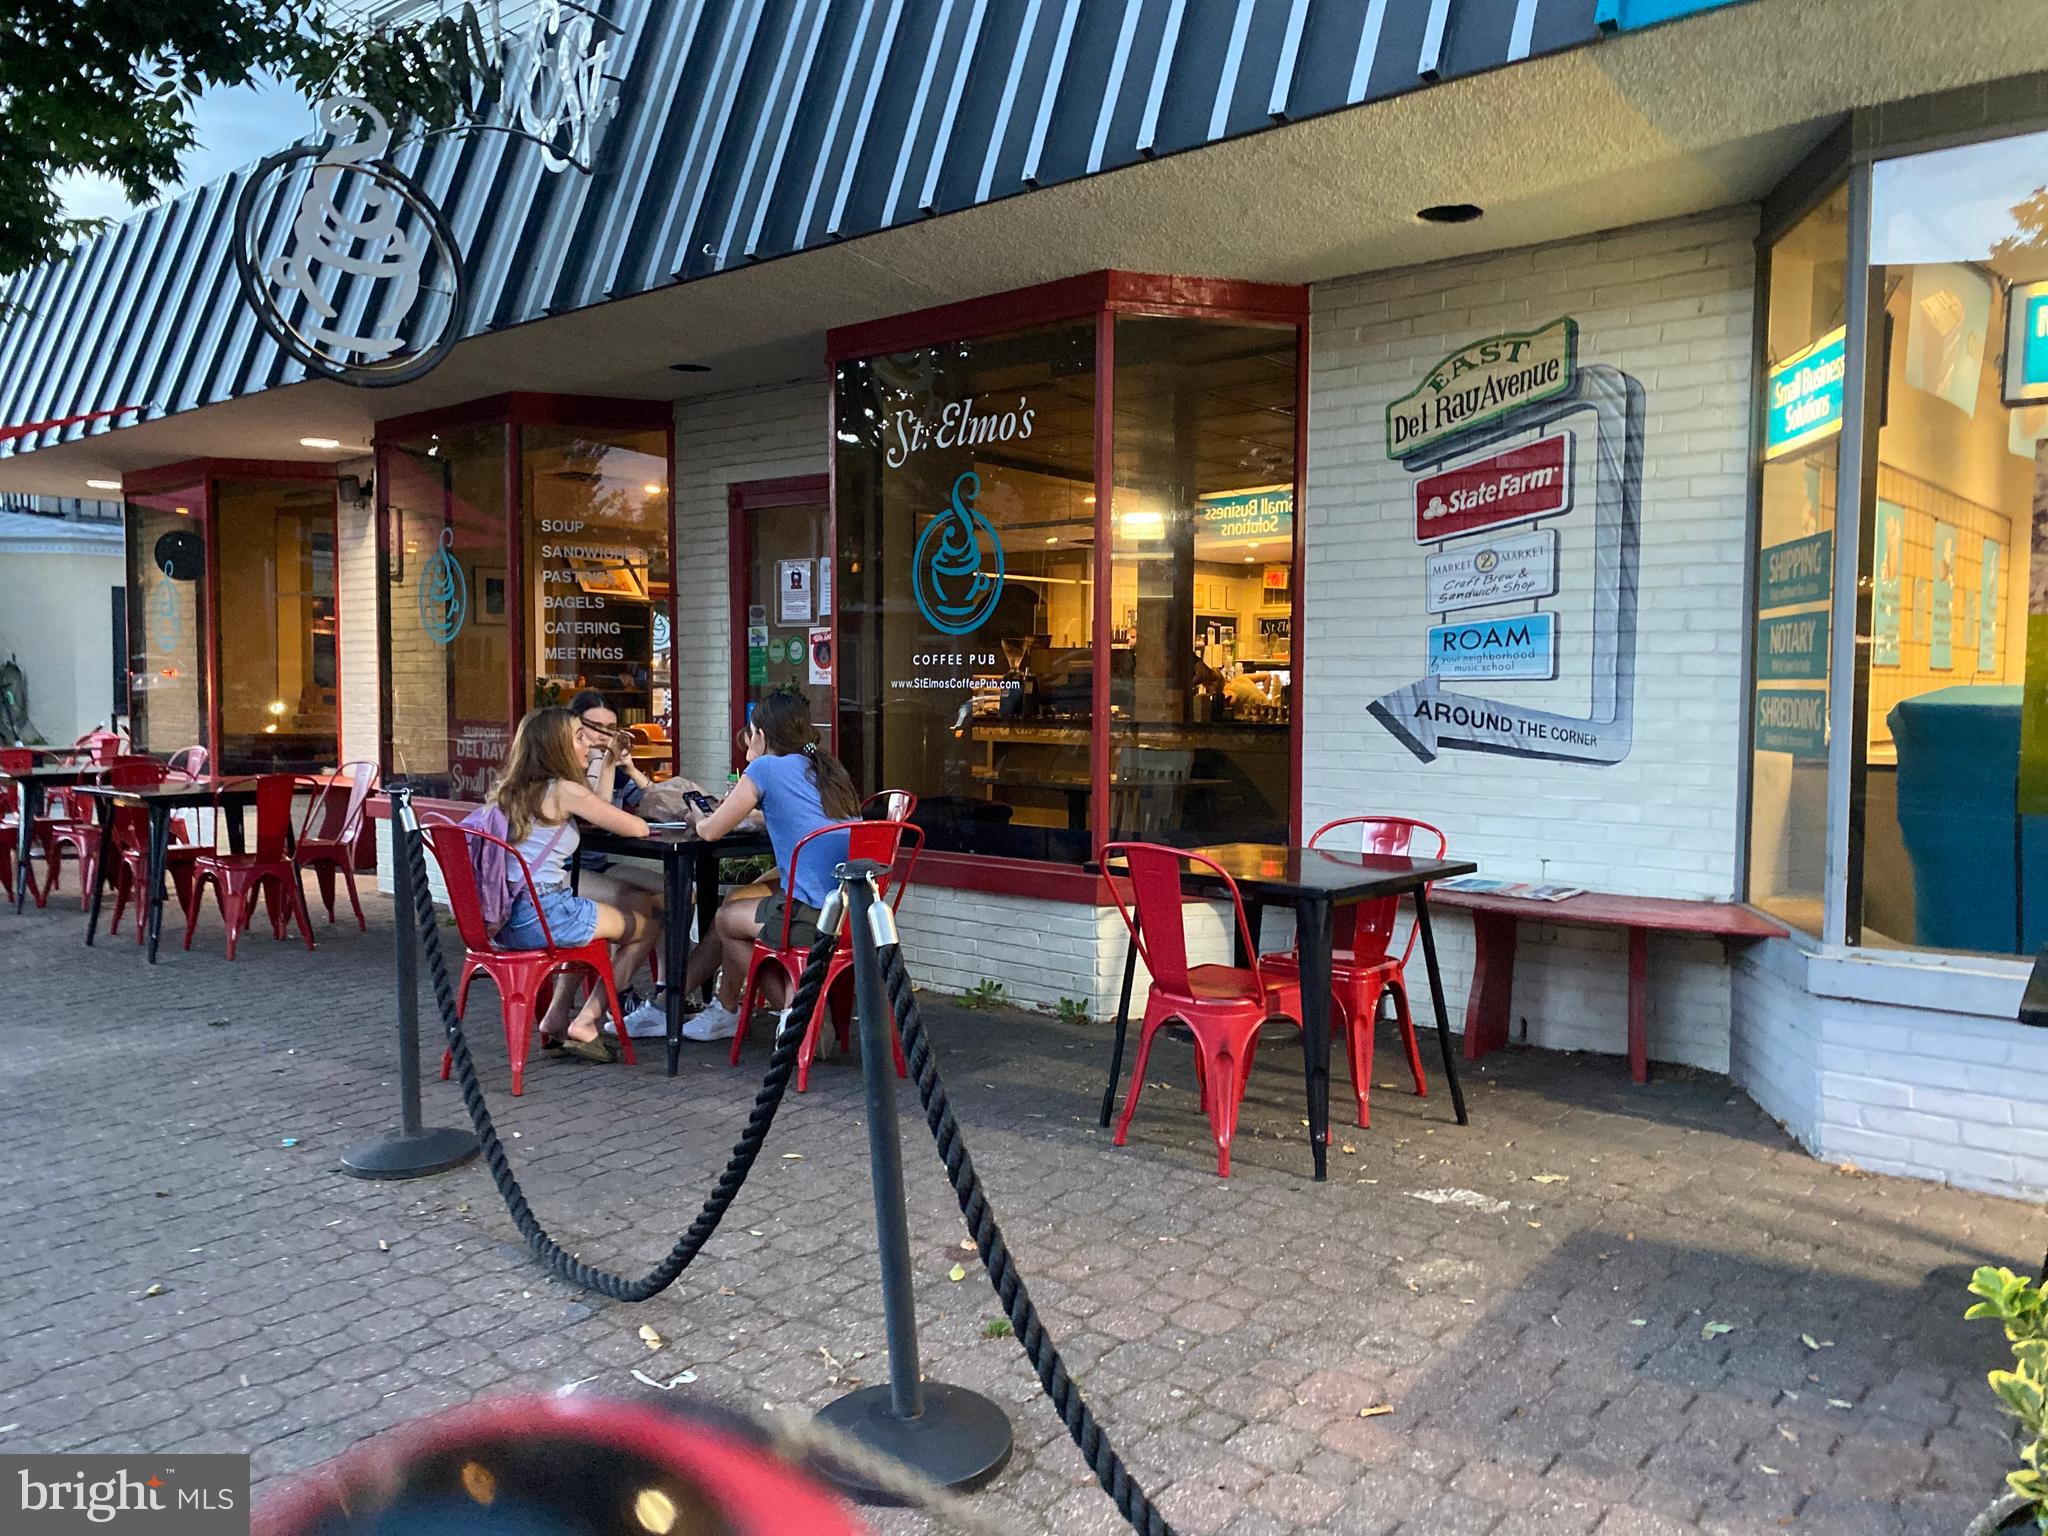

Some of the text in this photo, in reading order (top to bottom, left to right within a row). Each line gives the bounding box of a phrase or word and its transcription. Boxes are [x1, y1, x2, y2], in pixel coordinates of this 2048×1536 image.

[1427, 340, 1530, 395] EAST
[1394, 358, 1560, 445] Del Ray Avenue
[1784, 394, 1831, 434] Solutions
[886, 396, 1036, 469] St. Elmo's
[1448, 466, 1552, 514] State Farm
[541, 519, 585, 533] SOUP
[1432, 561, 1472, 576] MARKET
[1500, 546, 1545, 563] MARKET
[1769, 541, 1822, 584] SHIPPING
[1443, 567, 1529, 591] Craft Brew &
[1502, 579, 1536, 593] Shop
[544, 596, 605, 609] BAGELS
[544, 621, 621, 635] CATERING
[1443, 623, 1531, 652] ROAM
[1769, 619, 1817, 654] NOTARY
[545, 647, 624, 660] MEETINGS
[912, 653, 996, 666] COFFEE PUB
[1442, 648, 1535, 665] your neighborhood
[1454, 661, 1515, 672] music school
[890, 677, 1021, 690] www.StElmosCoffeePub.com
[1413, 699, 1598, 747] AROUND THE CORNER
[1760, 697, 1821, 731] SHREDDING
[463, 726, 502, 739] SUPPORT
[456, 740, 507, 760] DEL RAY
[452, 763, 485, 793] Small
